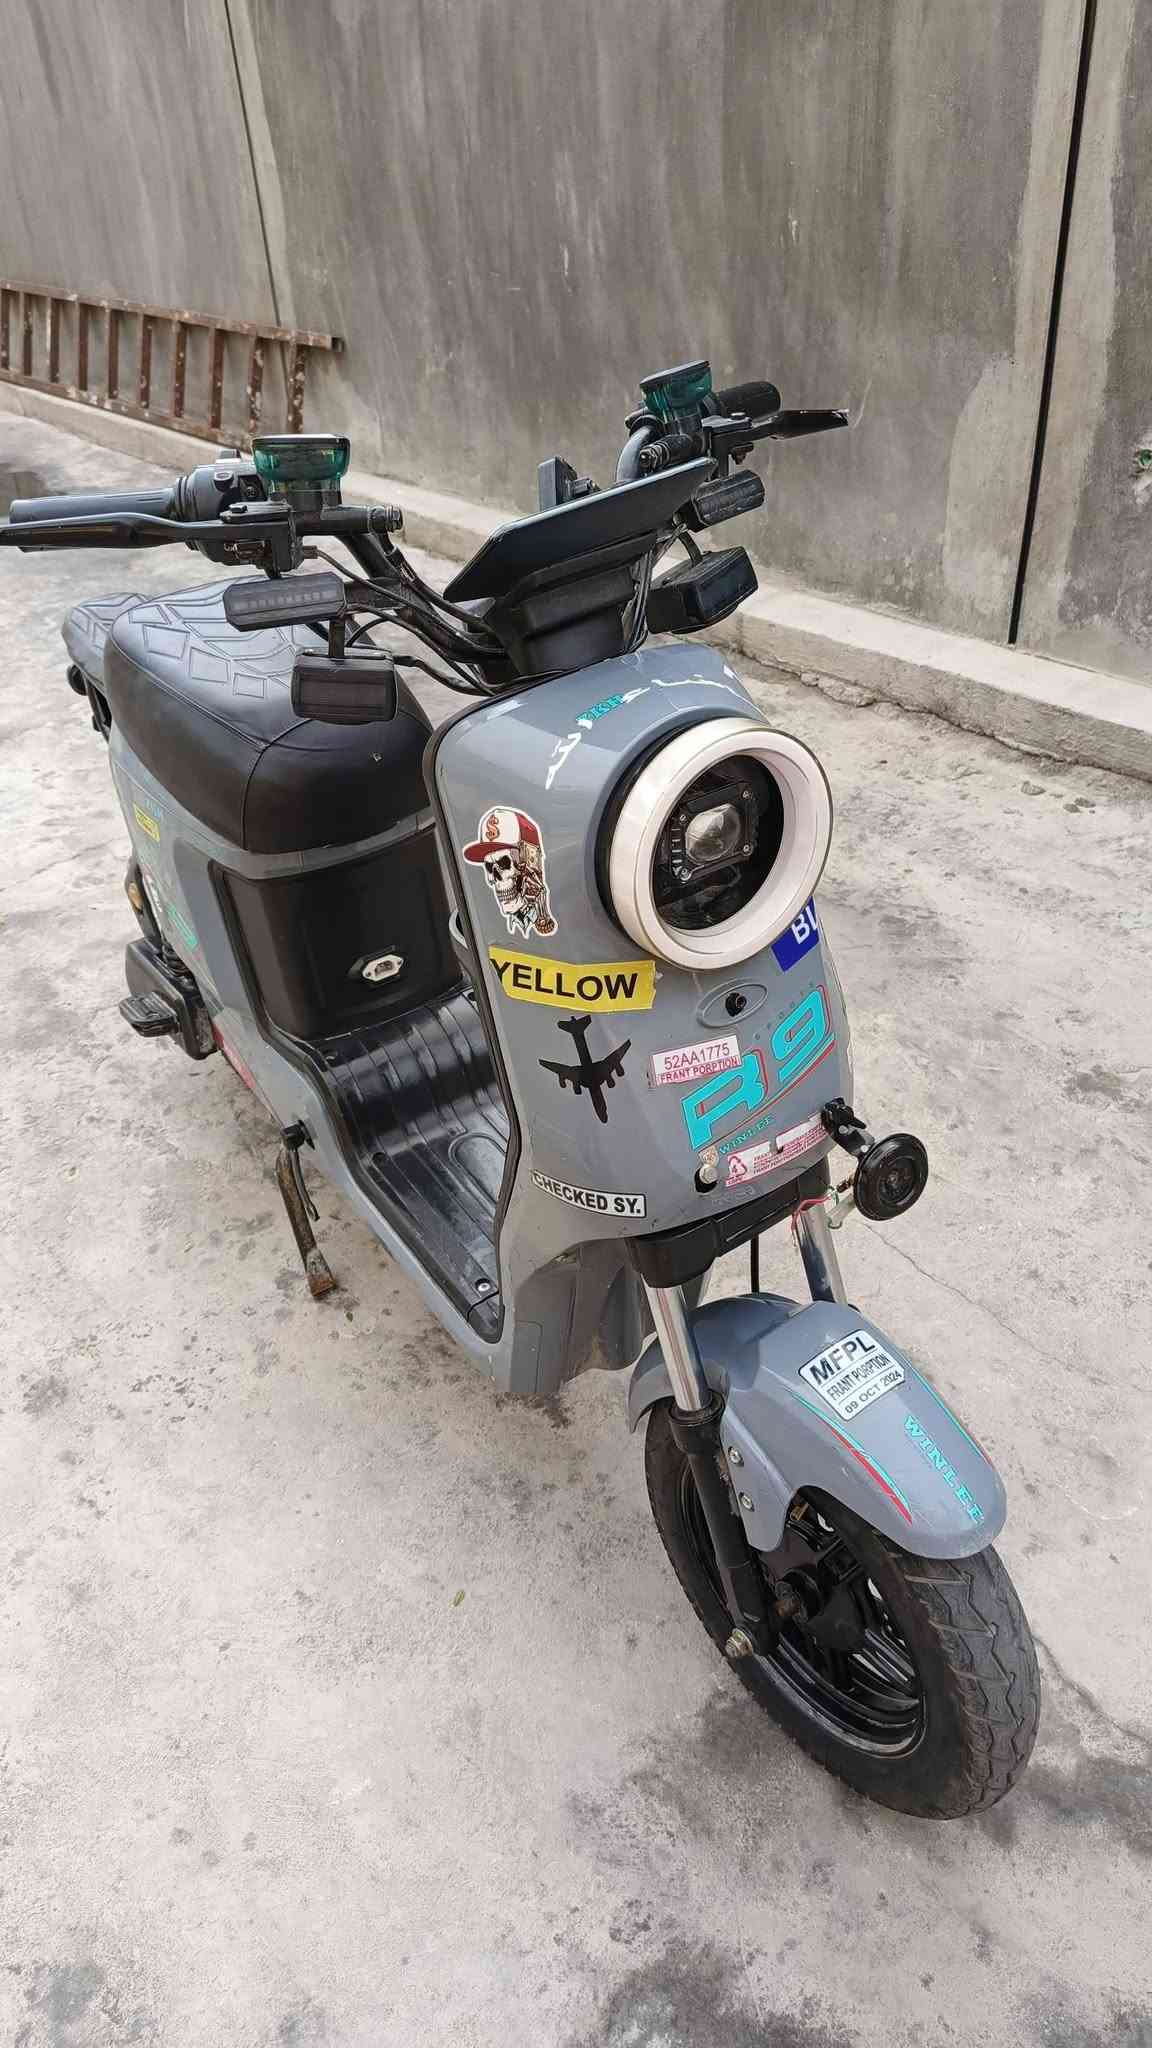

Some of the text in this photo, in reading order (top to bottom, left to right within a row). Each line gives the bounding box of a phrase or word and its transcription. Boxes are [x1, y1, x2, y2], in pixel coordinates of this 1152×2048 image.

[490, 958, 638, 1001] YELLOW
[660, 1056, 739, 1083] FRANT PORPTION
[664, 1042, 730, 1070] 52AA1775
[531, 1171, 641, 1214] CHECKED SY.
[809, 1336, 875, 1385] MFPL
[827, 1353, 892, 1401] FRANT PORPTION
[859, 1384, 881, 1402] OCT
[880, 1370, 903, 1387] 2024
[903, 1415, 985, 1526] WINLEE
